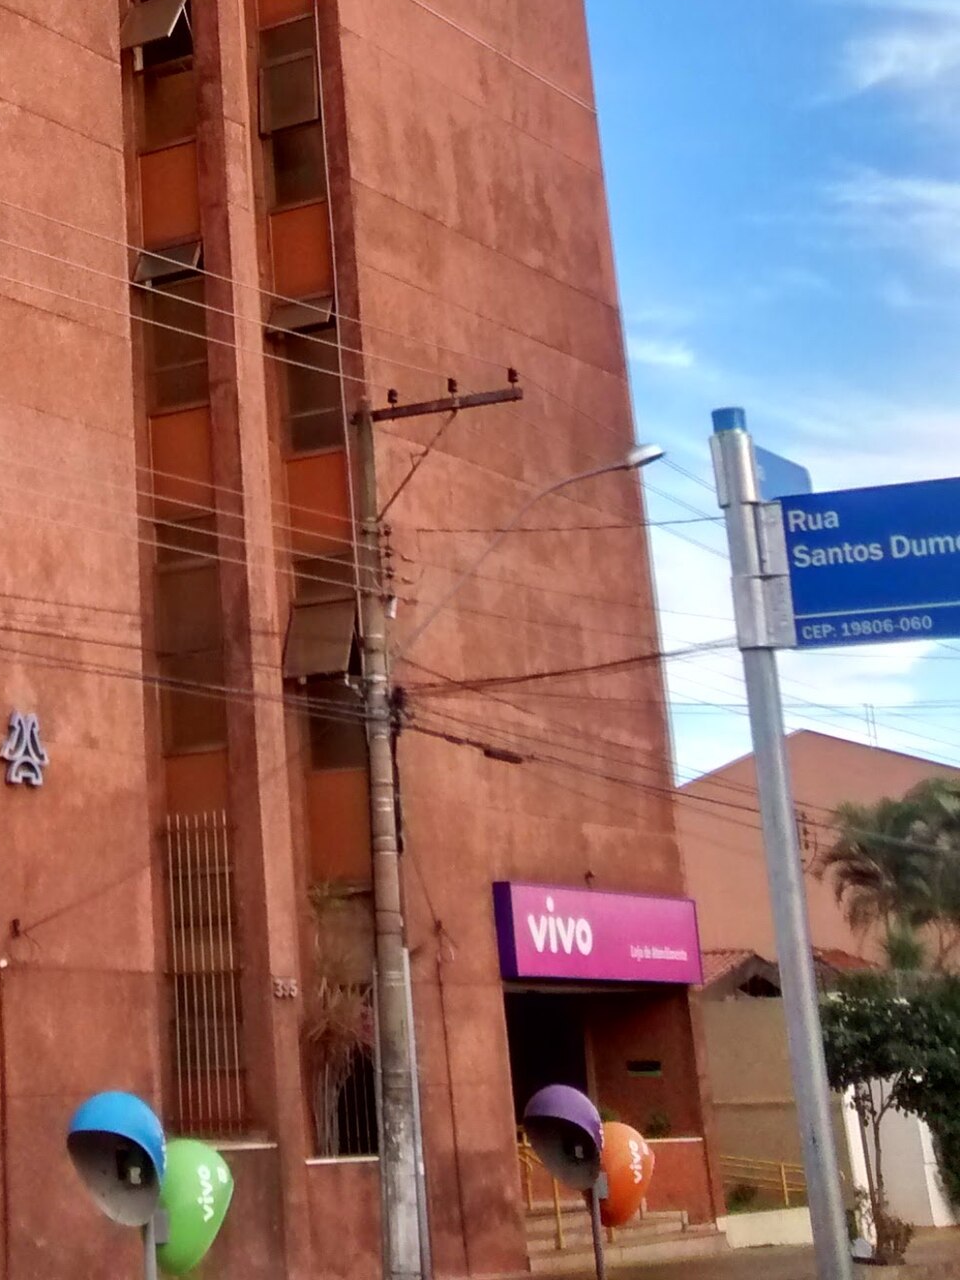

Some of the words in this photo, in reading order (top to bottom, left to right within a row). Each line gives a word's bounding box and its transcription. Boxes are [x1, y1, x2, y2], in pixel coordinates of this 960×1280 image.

[788, 510, 840, 532] Rua
[793, 543, 884, 568] Santos
[802, 623, 837, 640] CEP:
[842, 615, 932, 637] 19806-060
[527, 896, 593, 956] vivo
[628, 1139, 643, 1184] vivo
[197, 1165, 214, 1222] vivo
